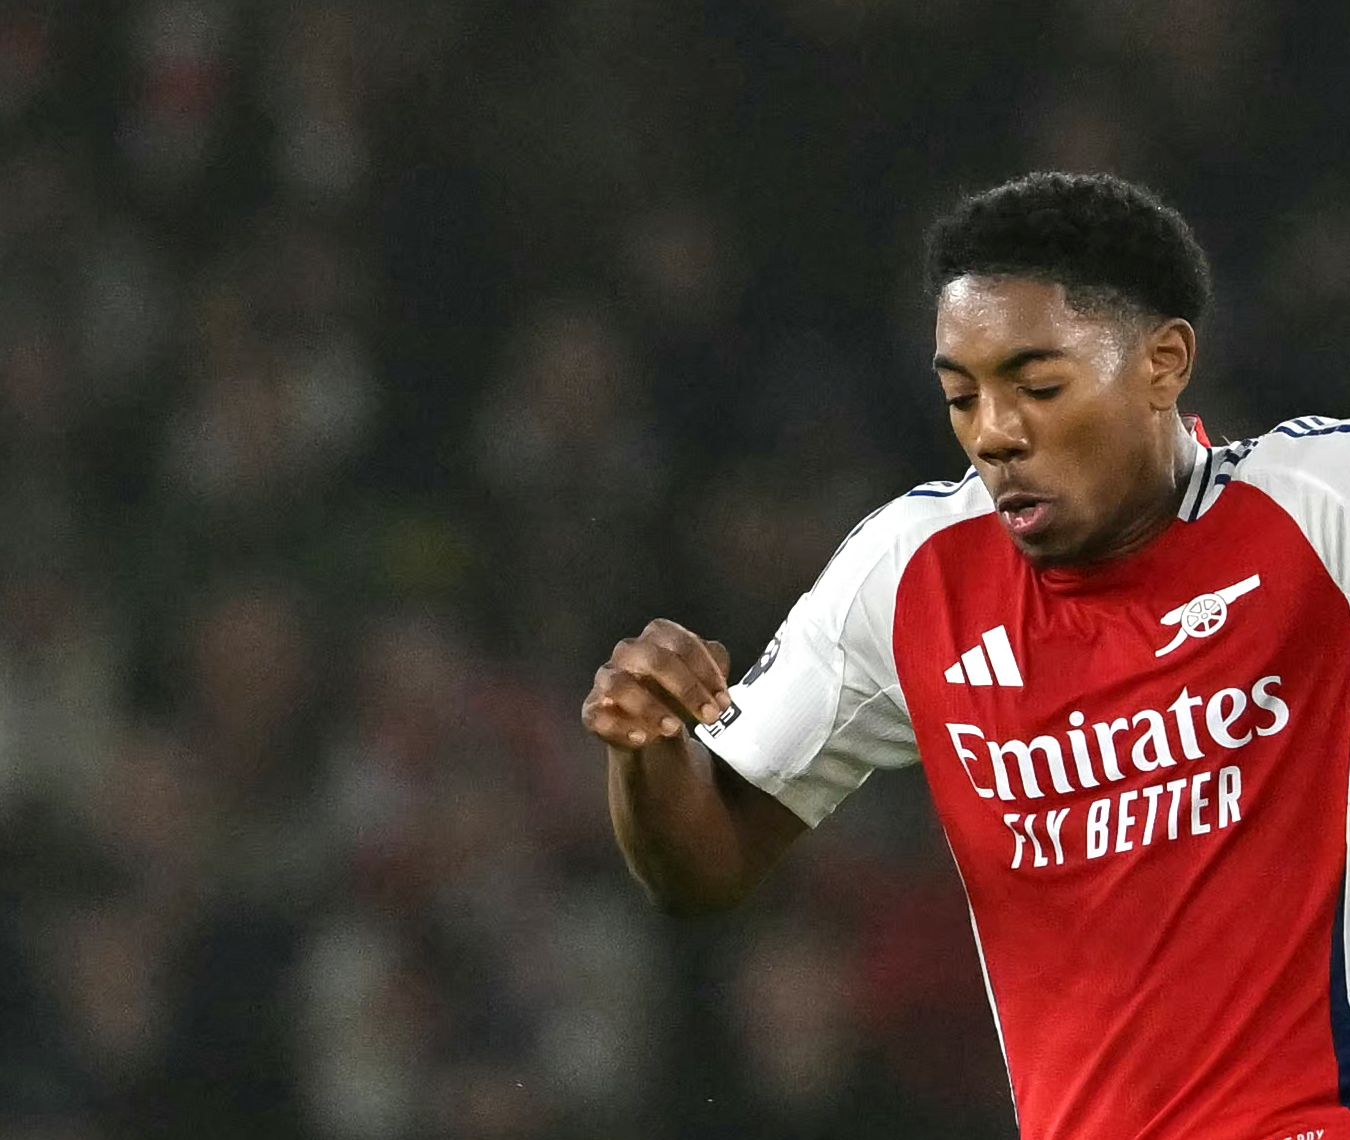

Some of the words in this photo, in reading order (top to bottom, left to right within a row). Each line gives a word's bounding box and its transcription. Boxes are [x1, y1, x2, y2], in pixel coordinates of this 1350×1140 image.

[945, 675, 1290, 801] Emirates
[1003, 808, 1071, 869] FLY
[1086, 765, 1242, 860] BETTER
